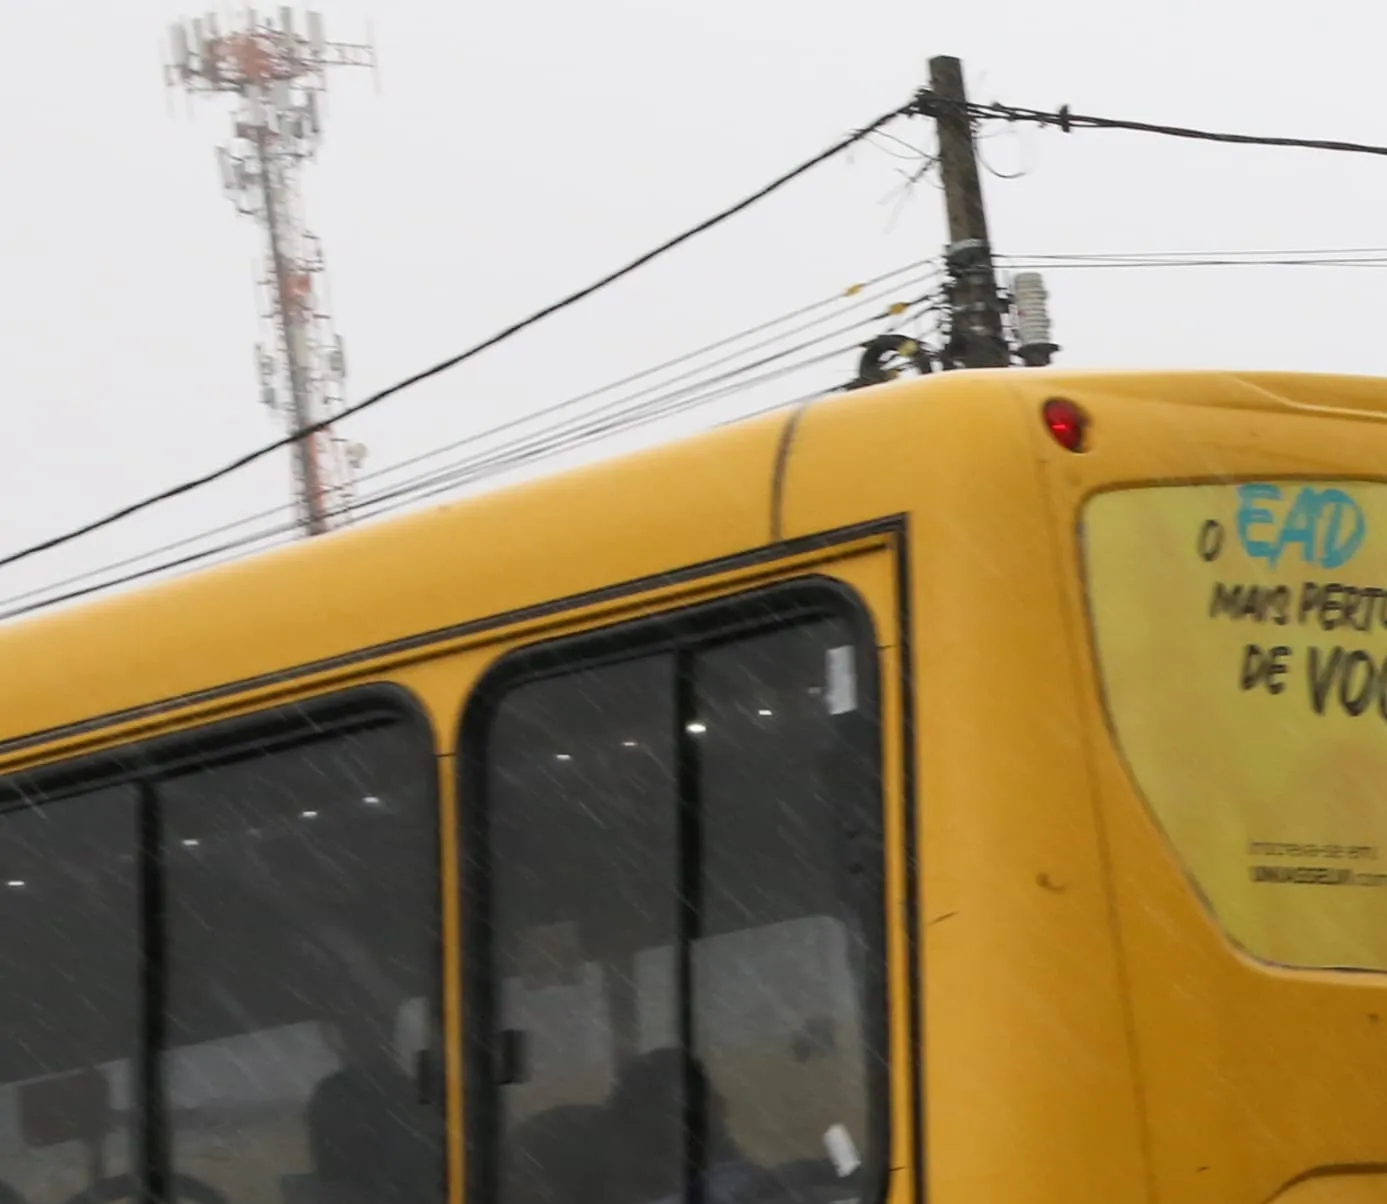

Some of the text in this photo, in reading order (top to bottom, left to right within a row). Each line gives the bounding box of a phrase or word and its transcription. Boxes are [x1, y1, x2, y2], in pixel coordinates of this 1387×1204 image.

[1197, 483, 1366, 569] O EAD
[1209, 581, 1291, 625] MAIS
[1240, 644, 1293, 695] DE
